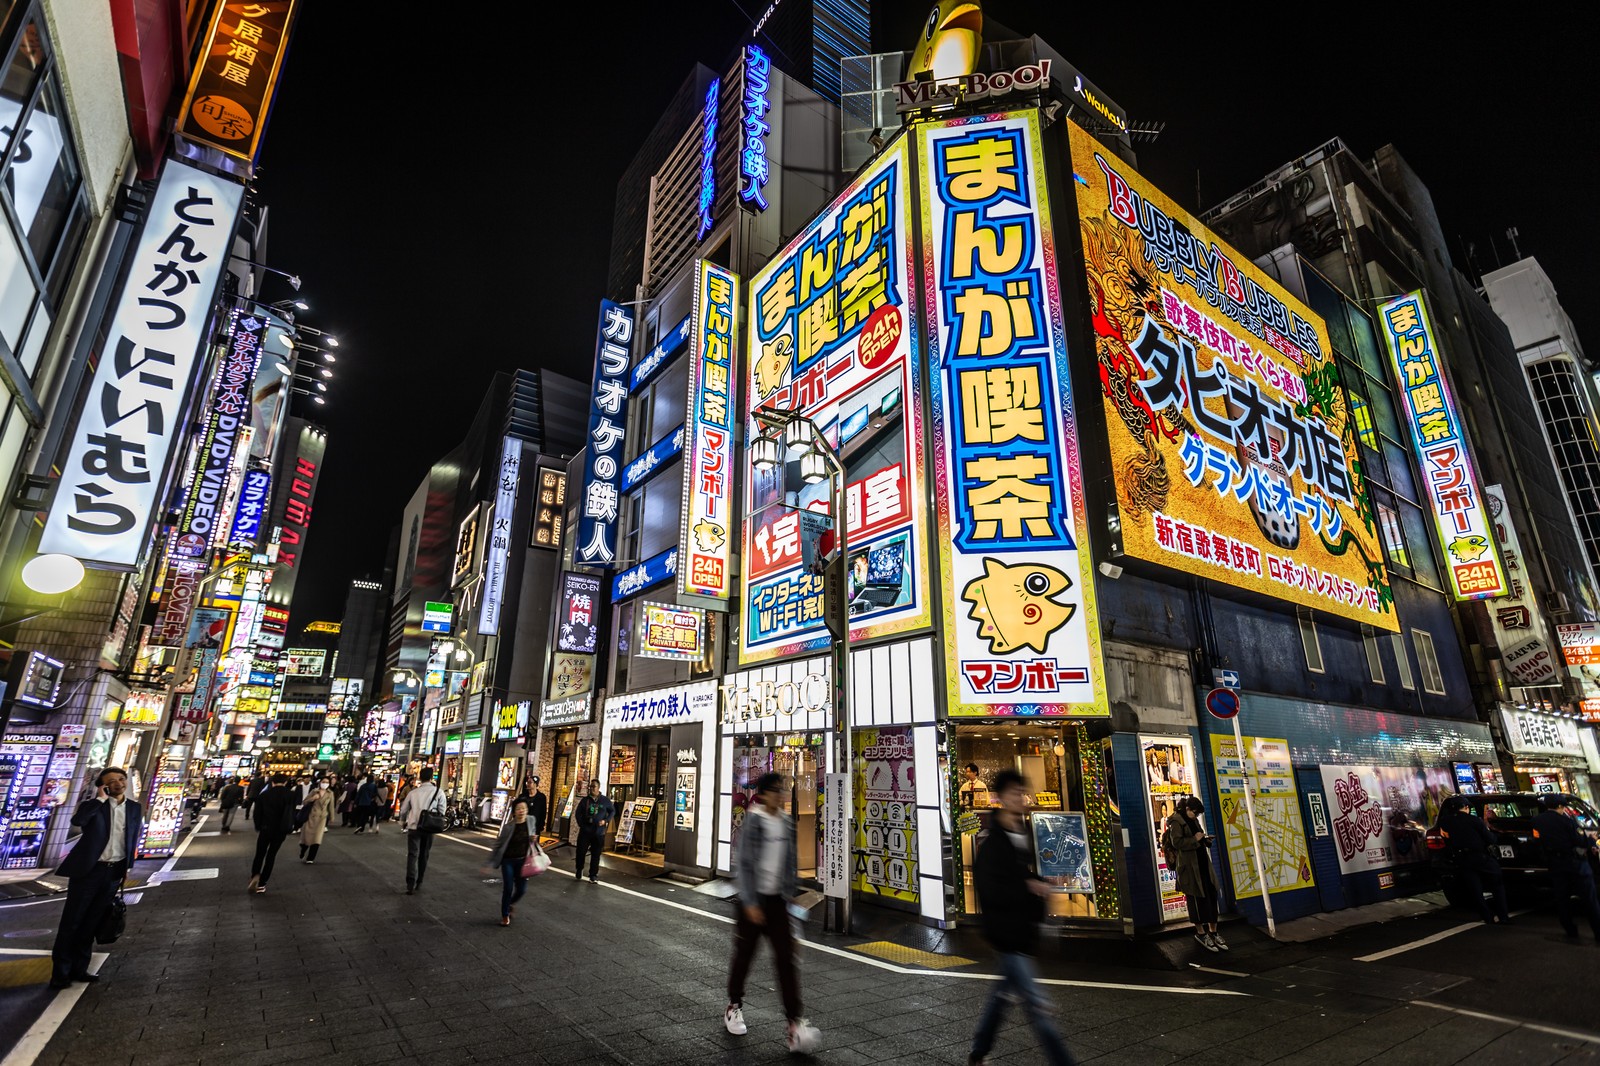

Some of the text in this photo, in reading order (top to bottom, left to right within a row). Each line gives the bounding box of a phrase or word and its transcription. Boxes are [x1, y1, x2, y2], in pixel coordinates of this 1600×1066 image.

[753, 5, 776, 37] HOTEL
[223, 110, 252, 124] SHUNKA
[741, 46, 770, 212] カラオケの鉄人
[764, 184, 887, 331] まんが
[1095, 153, 1322, 361] BUBBLY BUBBLES
[799, 252, 888, 352] 喫茶
[859, 312, 899, 349] 24h
[702, 273, 732, 427] まんが喫茶
[862, 328, 901, 364] OPEN
[945, 136, 1064, 544] まんが喫茶
[1162, 289, 1307, 399] 歌舞伎町さくら通り
[215, 331, 258, 414] ホテルがライバル
[1391, 305, 1452, 441] まんが喫茶
[580, 306, 634, 564] カラオケの鉄人
[1130, 316, 1352, 505] タピオカ店
[237, 472, 269, 531] カラオケ
[702, 430, 725, 518] マンボー
[1180, 434, 1342, 541] グランドオープン
[1425, 447, 1473, 533] マンボー
[279, 457, 316, 568] HUMAX
[771, 461, 902, 563] 完室
[694, 555, 722, 575] 24h
[1154, 514, 1262, 577] 新宿歌舞伎町
[1457, 565, 1494, 582] 24h
[566, 581, 600, 592] SEIKO-EN
[693, 572, 722, 588] OPEN
[754, 575, 826, 611] インターネッ
[1459, 576, 1496, 592] OPEN
[571, 593, 590, 627] 焼肉
[650, 638, 676, 647] PRIVATE
[1565, 647, 1593, 656] タイ古式
[240, 700, 258, 710] ゲーム
[962, 660, 1087, 692] マンボー
[621, 692, 691, 722] カラオケの鉄人
[1518, 716, 1563, 748] 回転寿司
